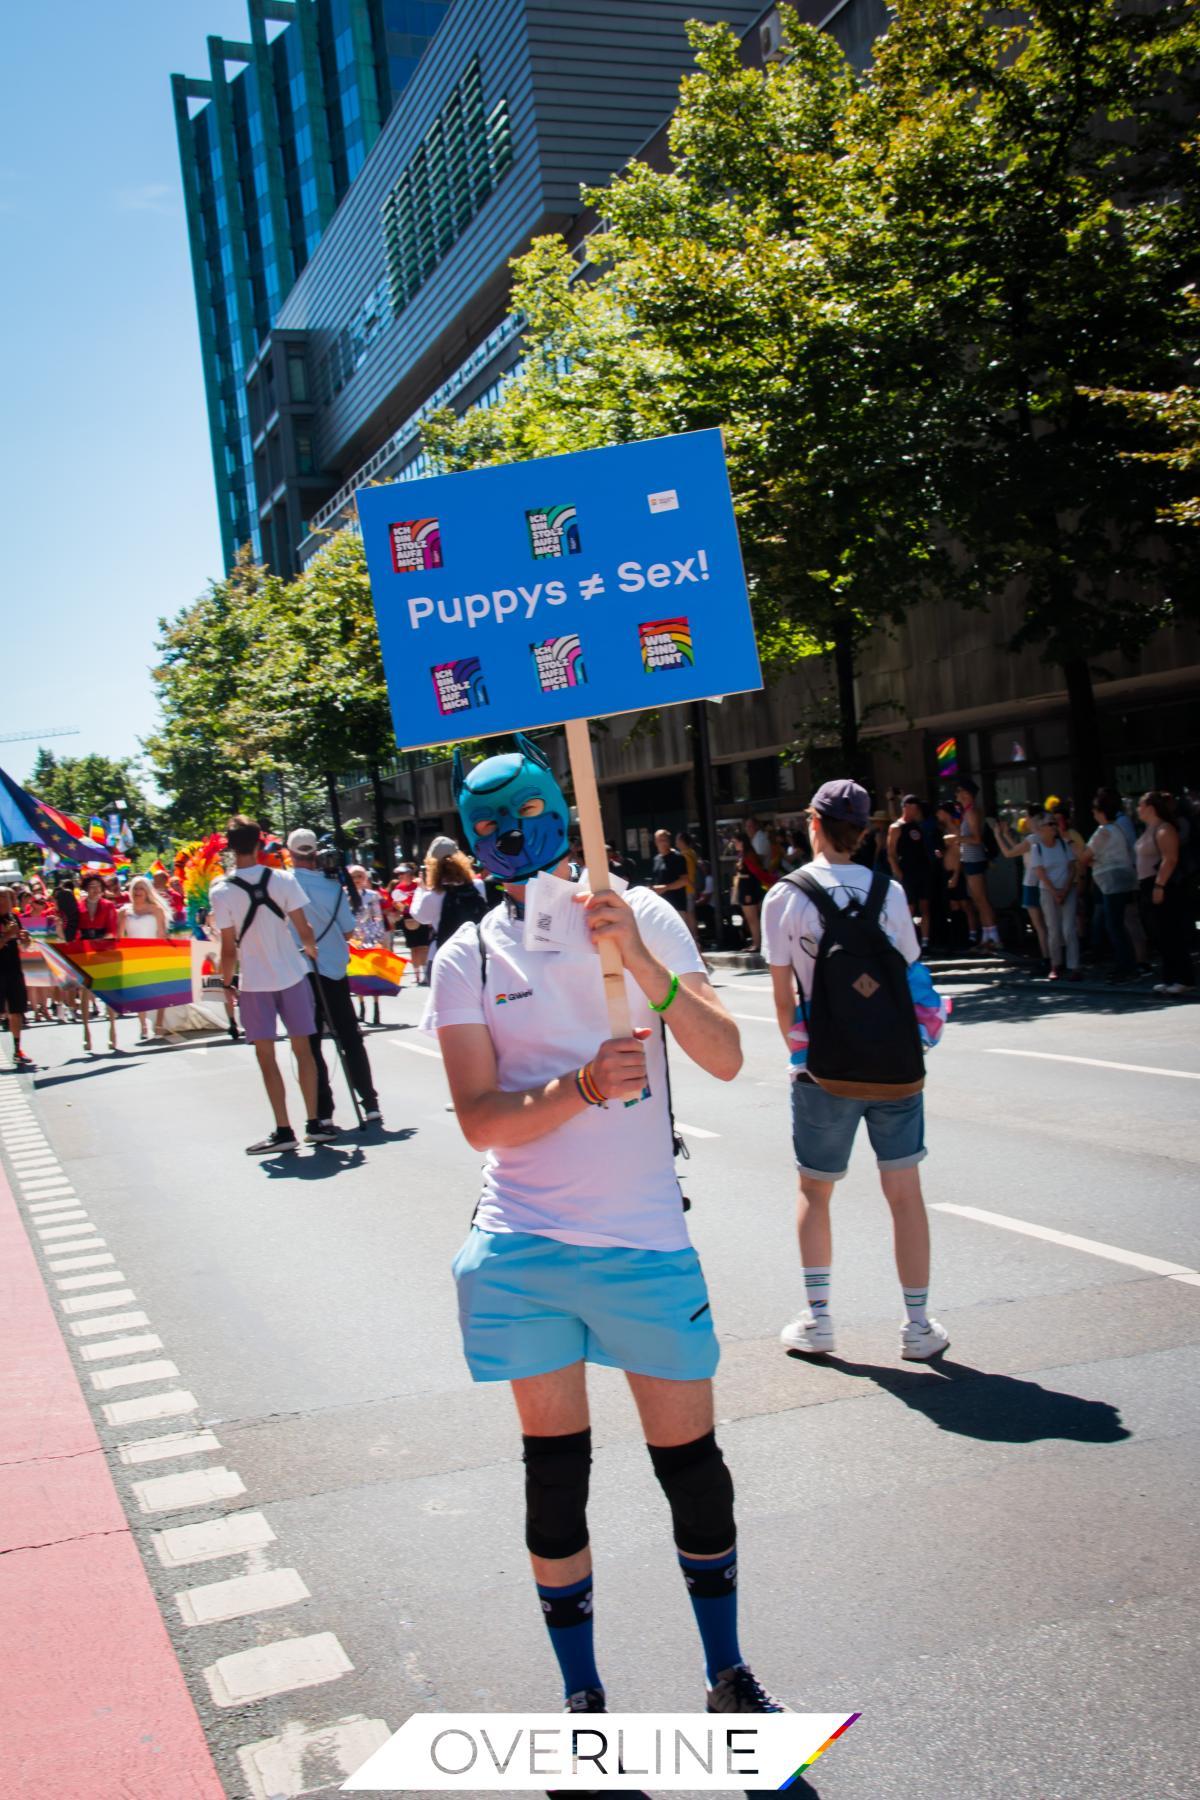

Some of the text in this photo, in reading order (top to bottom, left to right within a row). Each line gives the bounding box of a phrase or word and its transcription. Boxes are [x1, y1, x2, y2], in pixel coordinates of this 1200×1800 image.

[529, 514, 547, 523] ICH
[393, 526, 411, 536] ICH
[531, 521, 548, 531] BIN
[394, 534, 412, 543] BIN
[532, 527, 564, 539] STOLZ
[395, 540, 428, 552] STOLZ
[534, 544, 561, 555] MICH
[398, 557, 424, 567] MICH
[408, 581, 567, 629] Puppys
[617, 549, 710, 593] Sex!
[645, 633, 672, 646] WIR
[534, 646, 552, 656] ICH
[647, 643, 677, 657] SIND
[536, 653, 553, 664] BIN
[647, 652, 682, 667] BUNT
[538, 658, 569, 672] STOLZ
[435, 669, 453, 680] ICH
[437, 677, 454, 688] BIN
[541, 675, 567, 688] MICH
[439, 681, 471, 695] STOLZ
[443, 698, 469, 711] MICH
